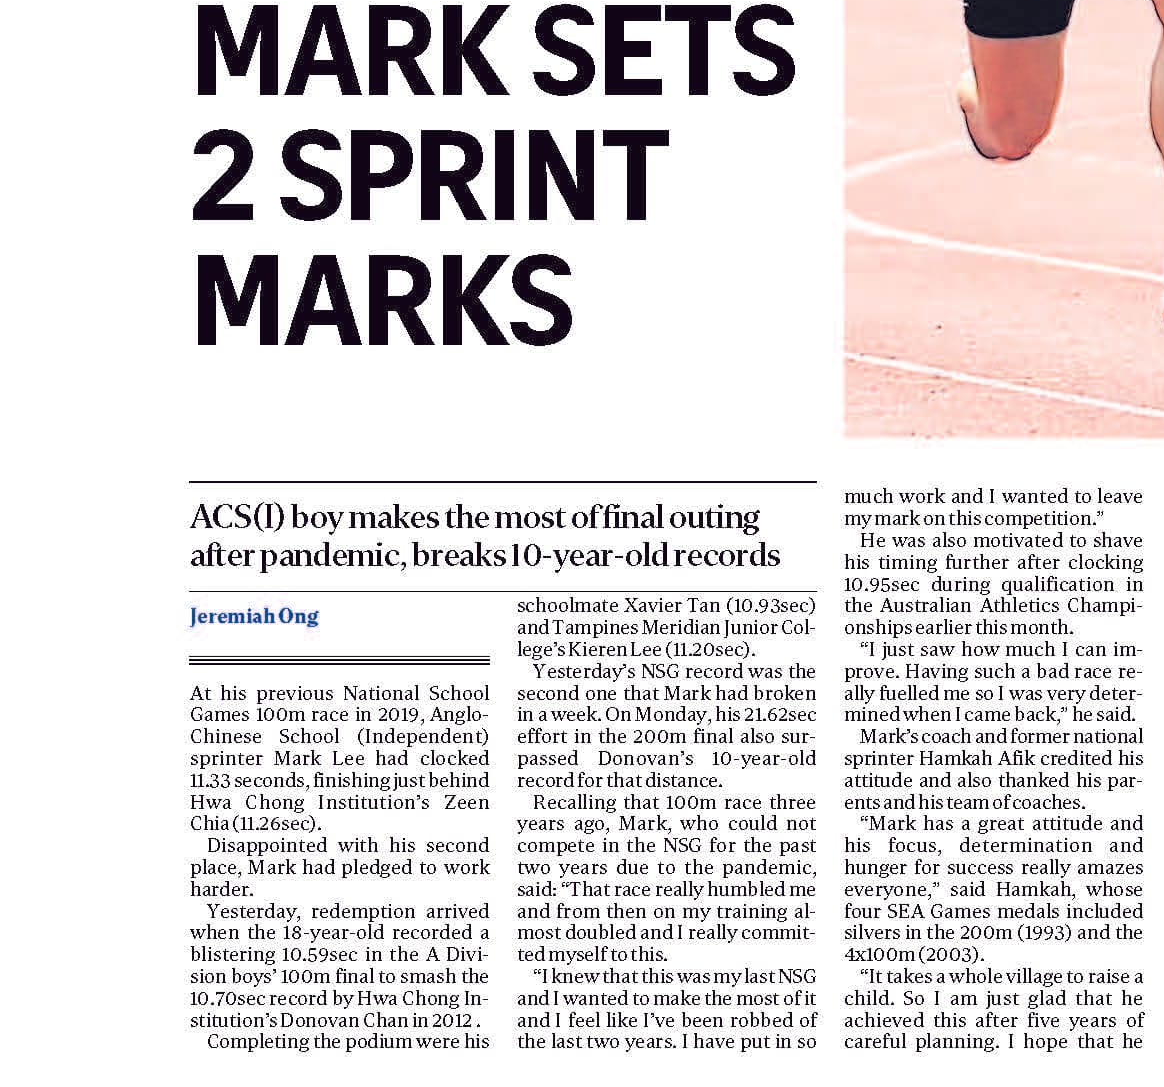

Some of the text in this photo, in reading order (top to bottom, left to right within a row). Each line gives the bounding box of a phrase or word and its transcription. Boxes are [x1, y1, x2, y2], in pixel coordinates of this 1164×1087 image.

[197, 3, 796, 97] MARK SETS
[192, 128, 670, 222] 2 SPRINT
[197, 253, 573, 347] MARKS
[189, 501, 761, 536] ACS(I) boy makes the most of final outing
[190, 541, 781, 574] after pandemic, breaks 10-year-old records
[844, 575, 1144, 596] 10.95sec during qualification in
[517, 596, 816, 616] schoolmate Xavier Tan (10.93sec)
[189, 607, 320, 628] Jeremiah Ong
[189, 684, 490, 705] At his previous National School
[844, 749, 1144, 770] sprinter Hamkah Afik credited his
[533, 793, 816, 814] Recalling that 100m race three
[207, 836, 490, 857] Disappointed with his second
[844, 858, 1144, 879] hunger for success really amazes
[844, 902, 1144, 919] four SEA Games medals included
